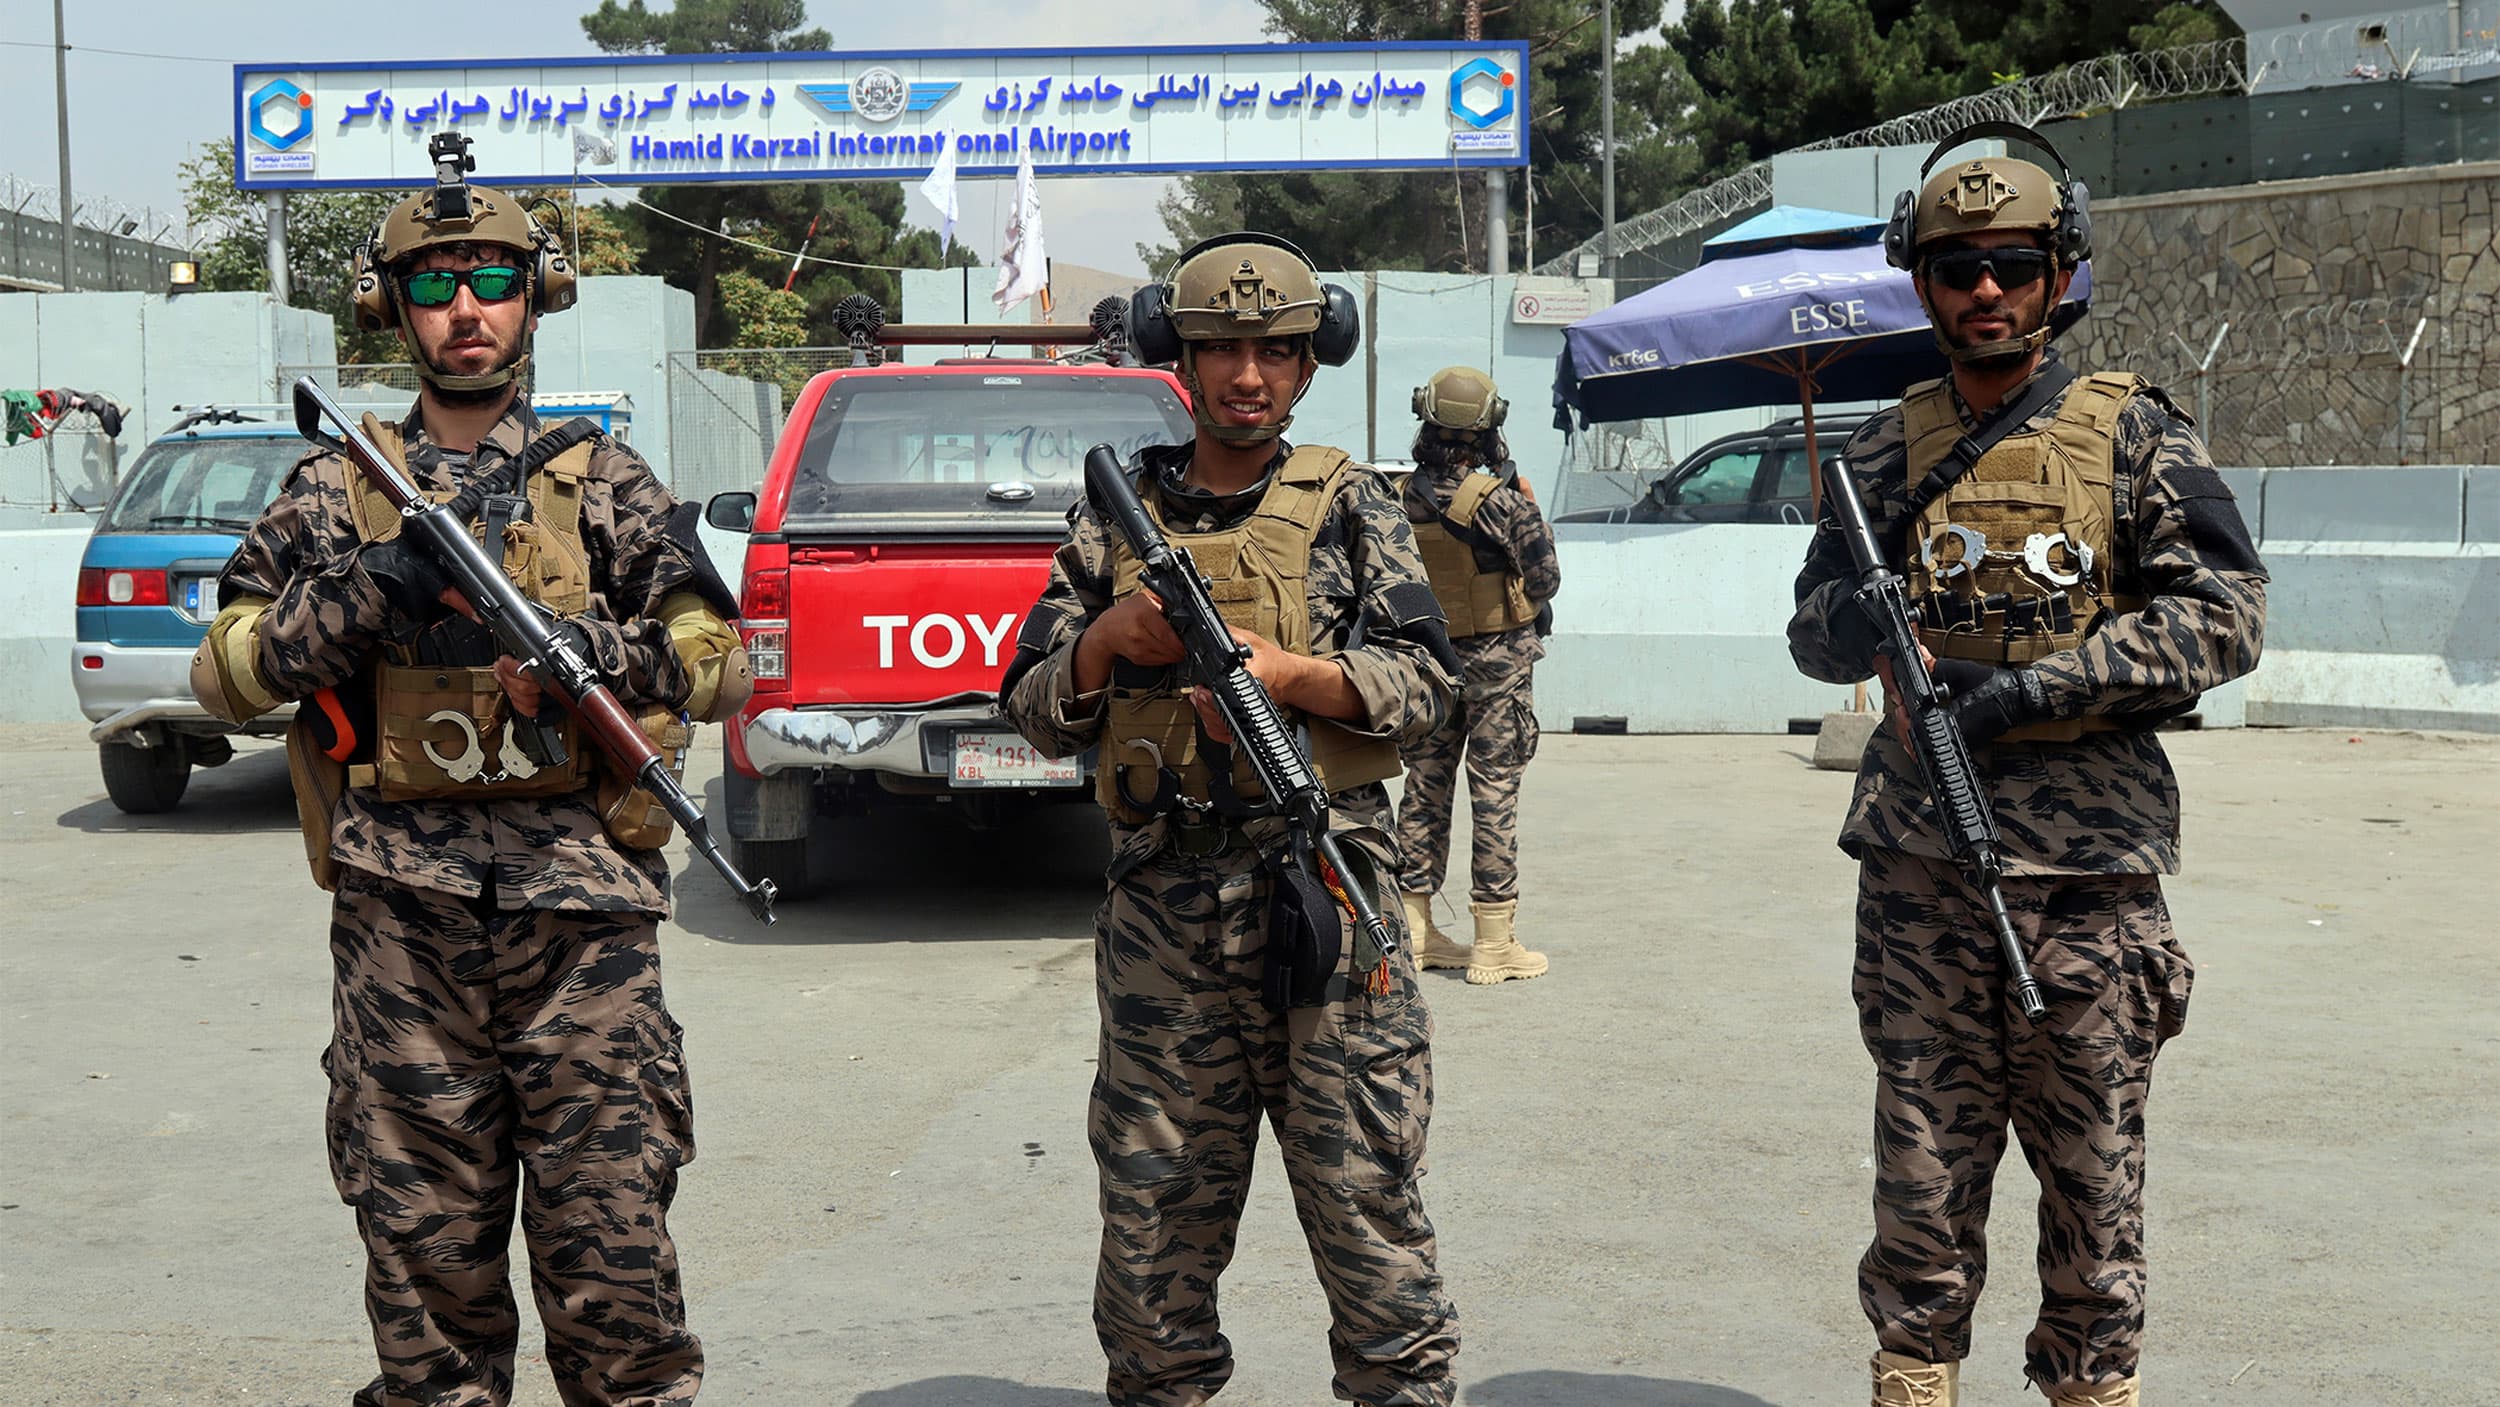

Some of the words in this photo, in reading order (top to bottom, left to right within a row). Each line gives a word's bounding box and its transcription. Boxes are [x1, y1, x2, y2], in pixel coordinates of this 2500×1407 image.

[688, 81, 750, 109] حامد
[760, 85, 776, 107] د
[983, 75, 1053, 112] کرزی
[1060, 74, 1125, 102] حامد
[1131, 73, 1211, 109] المللی
[1218, 81, 1260, 107] بین
[1268, 72, 1344, 108] هوایی
[1350, 71, 1427, 105] میدان
[631, 133, 723, 160] Hamid
[731, 130, 821, 159] Karzai
[829, 126, 1019, 155] Internatonal
[1029, 125, 1131, 157] Airport
[1789, 299, 1868, 335] ESSE
[1608, 348, 1659, 368] KT&G
[862, 613, 1026, 669] TOY
[995, 746, 1037, 769] 1351
[957, 766, 985, 780] KBL
[1044, 769, 1076, 780] POLICE
